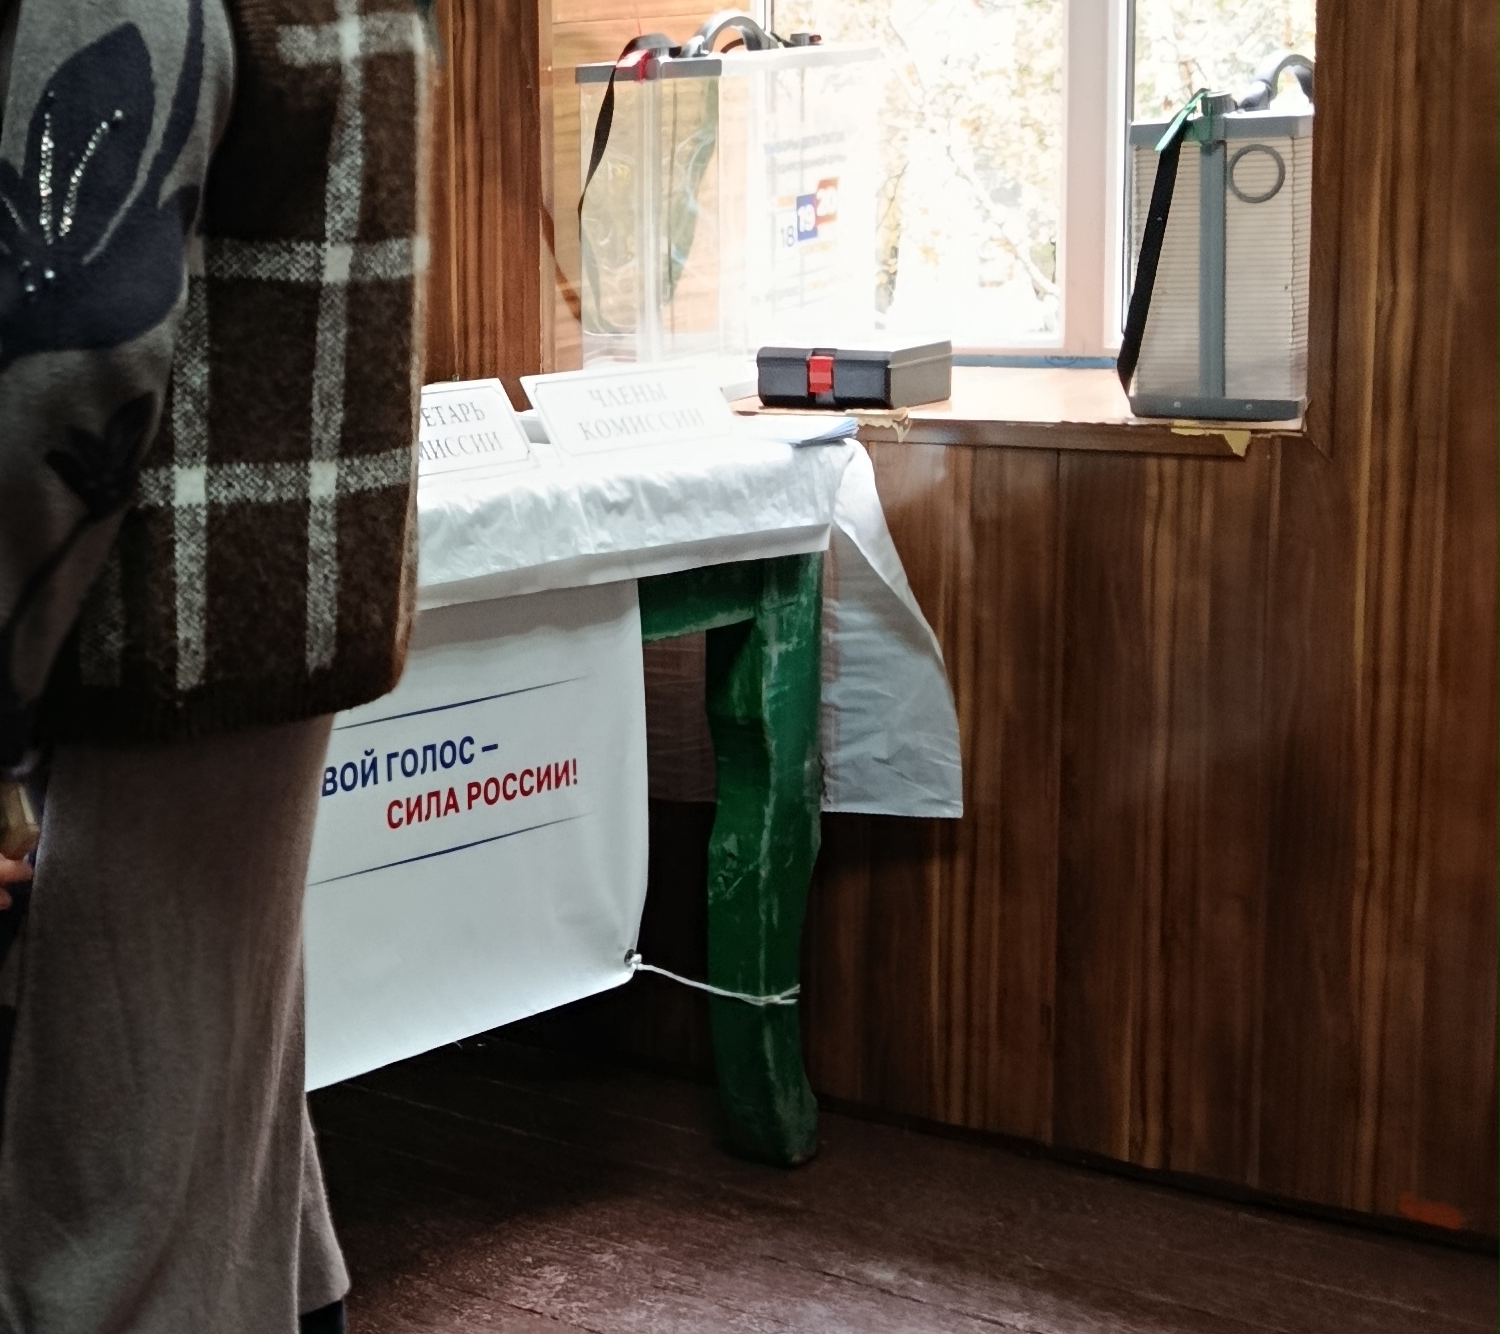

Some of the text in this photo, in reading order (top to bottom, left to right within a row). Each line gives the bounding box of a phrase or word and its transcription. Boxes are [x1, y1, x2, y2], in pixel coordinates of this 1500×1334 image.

[589, 382, 668, 409] ЧЛЕНЫ
[420, 402, 486, 427] ЕТАРЬ
[578, 408, 706, 441] КОМИССИИ
[419, 431, 505, 461] МИССИИ
[321, 748, 379, 797] ВОЙ
[387, 736, 475, 782] ГОЛОС
[387, 758, 579, 829] СИЛА РОССИИ!
